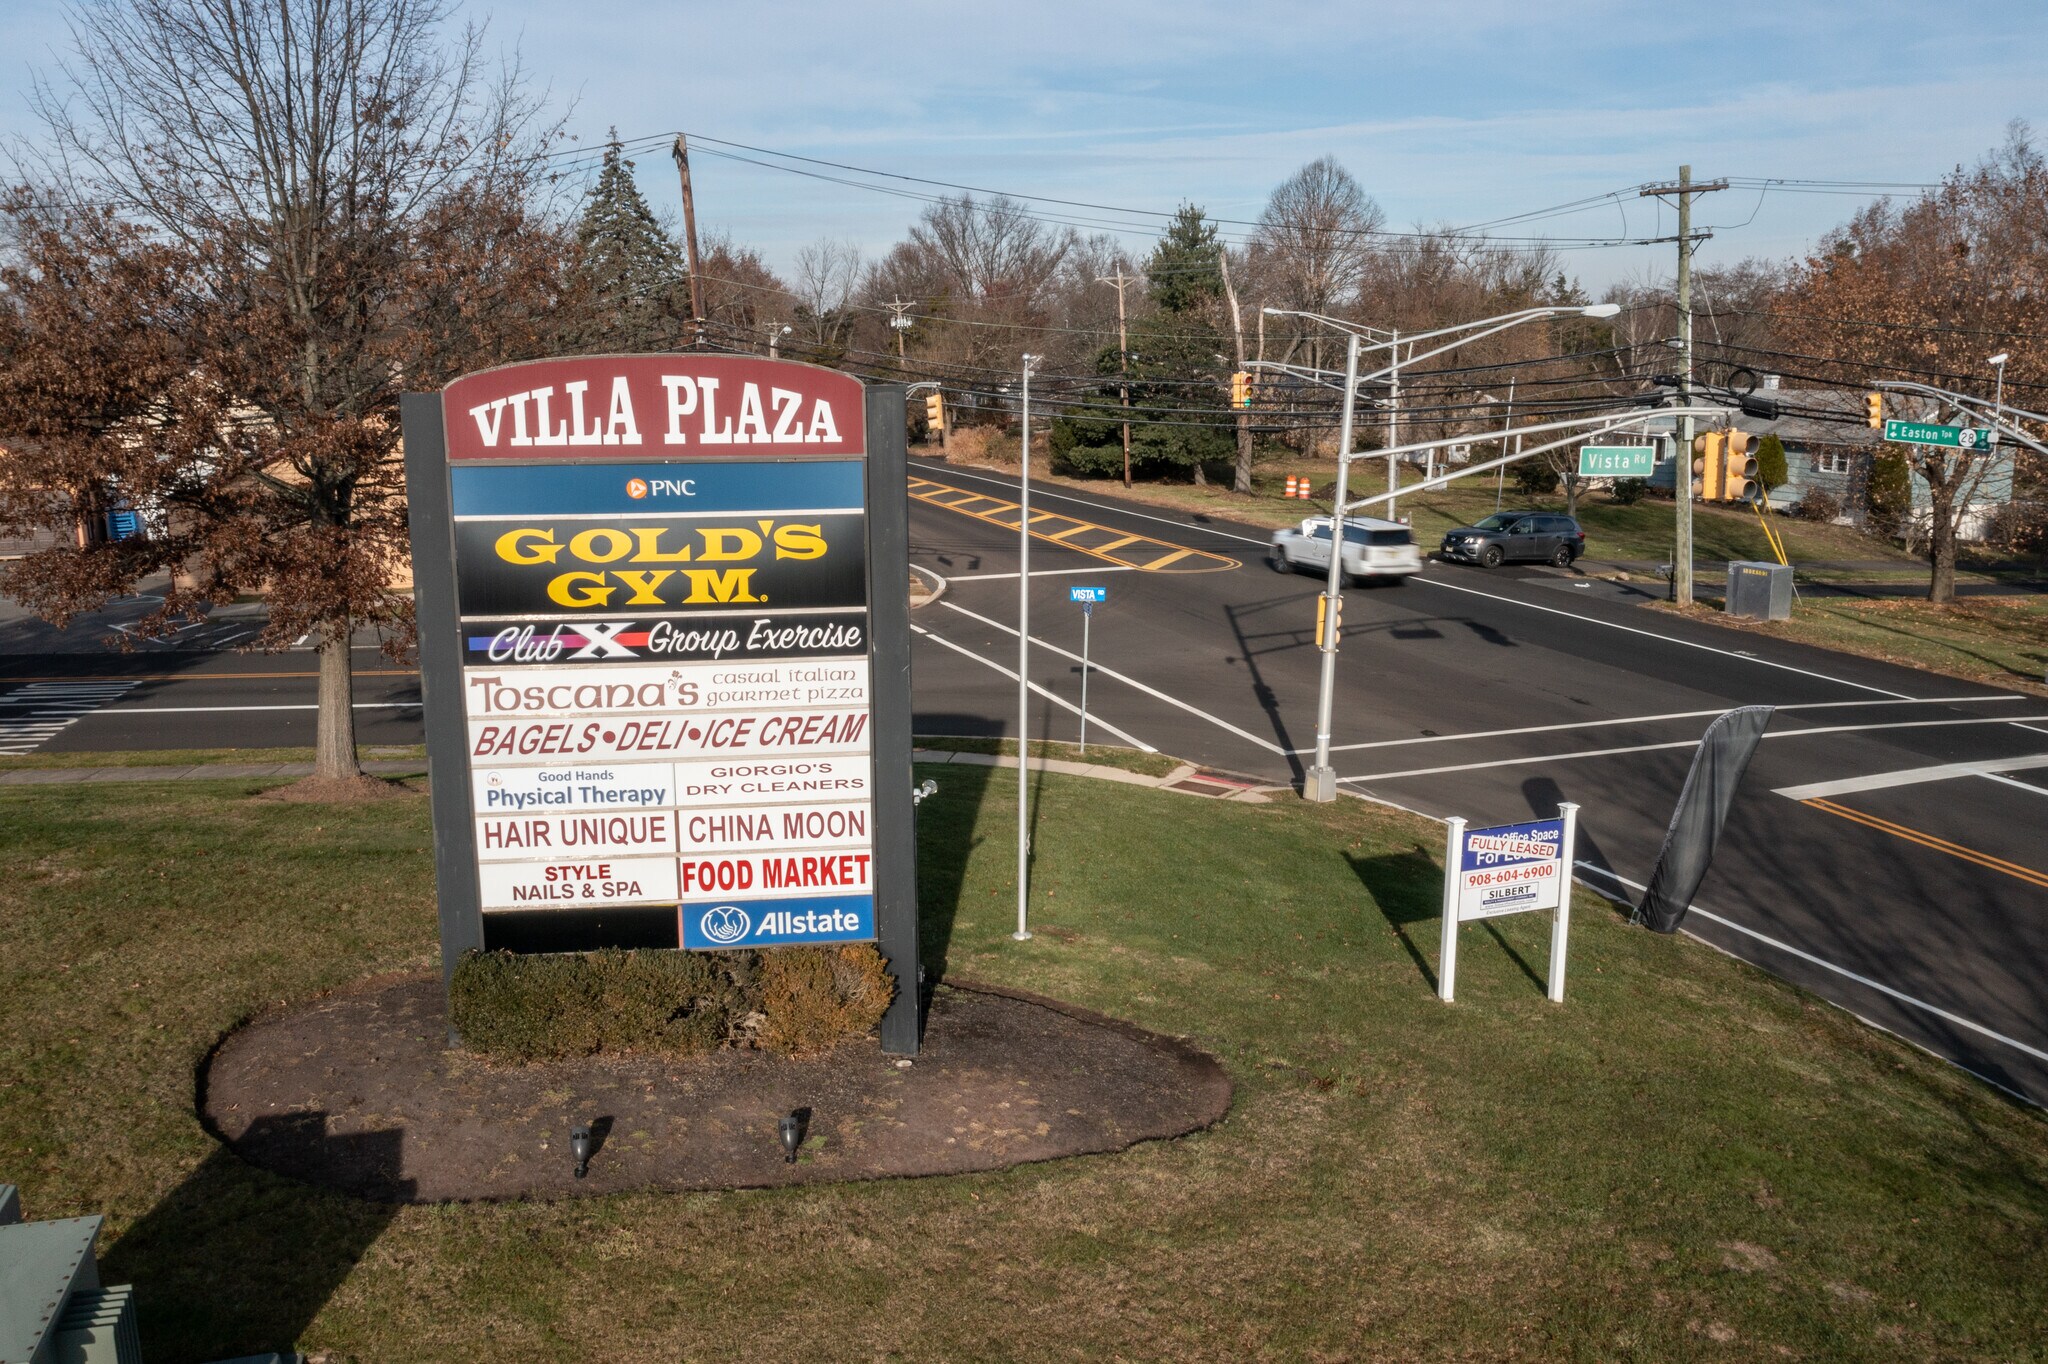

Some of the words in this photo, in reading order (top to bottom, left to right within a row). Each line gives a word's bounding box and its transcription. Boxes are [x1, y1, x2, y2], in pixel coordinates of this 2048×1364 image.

[469, 376, 643, 448] VILLA
[661, 375, 843, 446] PLAZA
[1901, 426, 1938, 440] Easton
[1941, 430, 1953, 439] Tpk
[1960, 432, 1975, 444] 28
[1981, 431, 1987, 439] E
[1588, 453, 1630, 469] Vista
[1634, 454, 1647, 464] Rd
[649, 479, 696, 497] PNC
[494, 520, 828, 566] GOLD'S
[1072, 590, 1095, 599] VISTA
[488, 624, 564, 662] Club
[563, 621, 641, 660] X
[646, 621, 739, 660] Group
[745, 619, 862, 652] Exercise
[712, 668, 781, 685] casual
[789, 667, 856, 682] italian
[470, 671, 700, 713] Toscana's
[706, 686, 801, 707] gourmet
[808, 686, 864, 702] pizza
[759, 713, 869, 746] CREAM
[538, 770, 573, 782] Good
[575, 769, 615, 781] Hands
[710, 763, 833, 778] GIORGIO'S
[686, 783, 733, 796] DRY
[738, 778, 865, 793] CLEANERS
[487, 786, 573, 810] Physical
[578, 785, 666, 807] Therapy
[484, 820, 551, 849] HAIR
[561, 816, 667, 847] UNIQUE
[688, 814, 774, 843] CHINA
[783, 810, 866, 840] MOON
[1531, 830, 1558, 841] Space
[1471, 837, 1508, 851] FULLY
[1509, 840, 1555, 857] LEASED
[544, 864, 612, 882] STYLE
[682, 859, 754, 892] FOOD
[762, 855, 871, 889] MARKET
[1469, 865, 1552, 886] 908-604-6900
[512, 884, 575, 901] NAILS
[581, 883, 596, 898] &
[602, 881, 643, 898] SPA
[1489, 885, 1532, 899] SILBERT
[755, 908, 860, 937] Allstate
